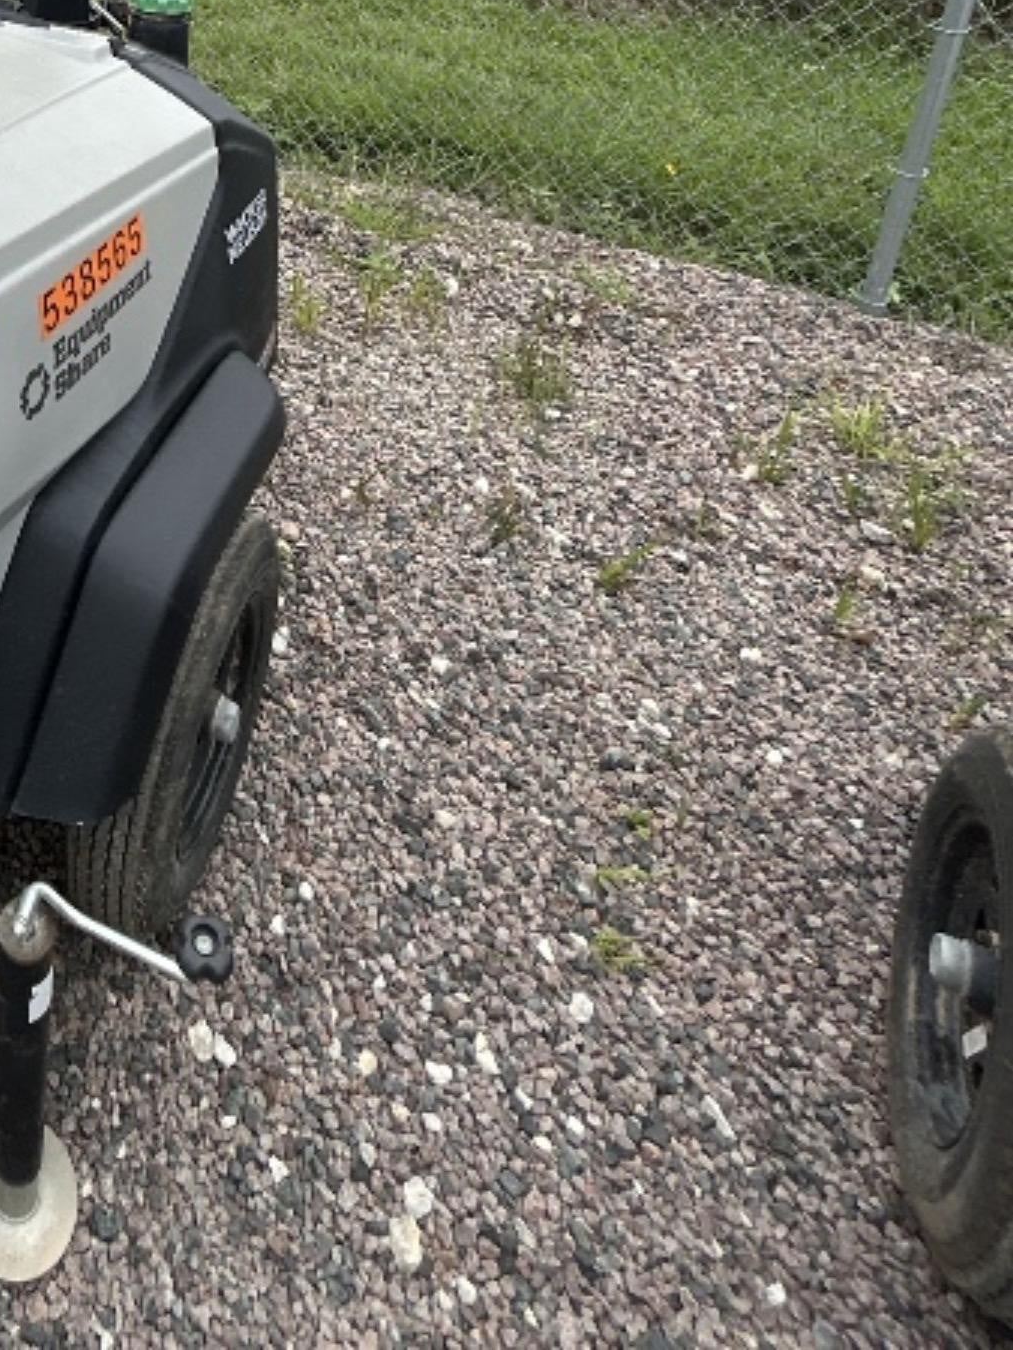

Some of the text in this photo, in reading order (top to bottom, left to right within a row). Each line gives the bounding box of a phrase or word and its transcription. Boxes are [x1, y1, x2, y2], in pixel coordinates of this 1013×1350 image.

[41, 216, 143, 333] 538565
[51, 259, 153, 370] Equipment
[54, 332, 112, 401] Share
